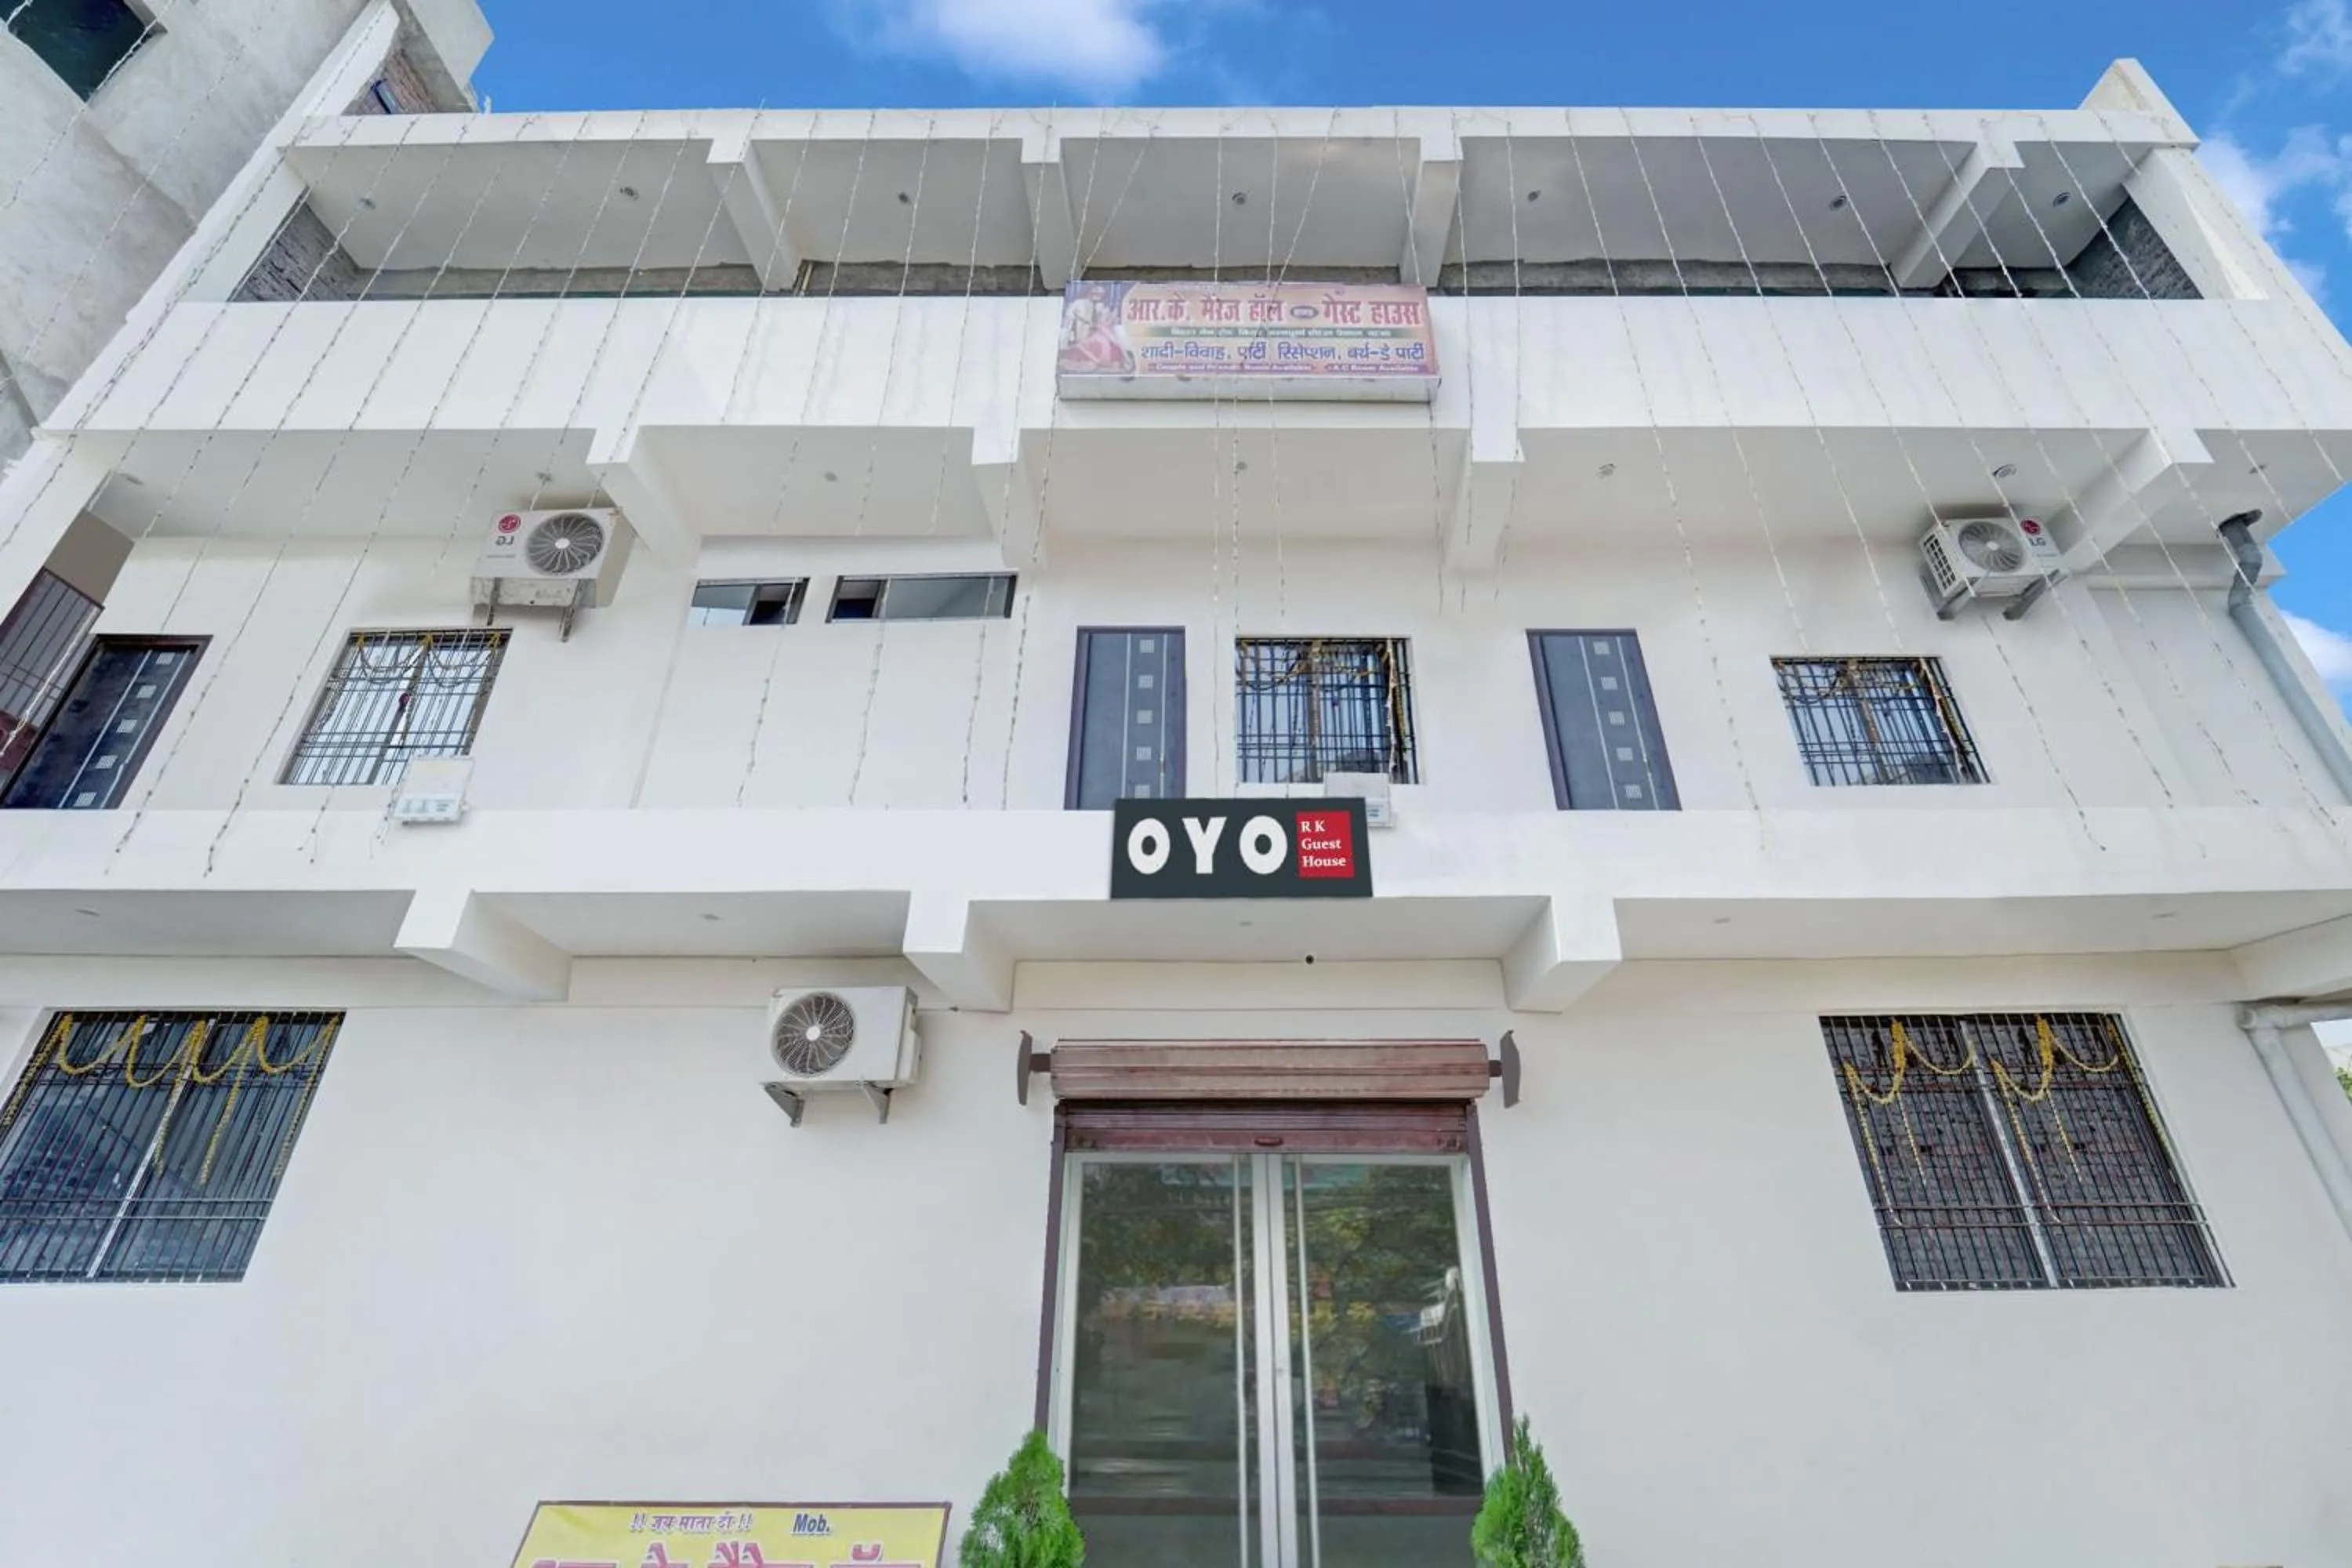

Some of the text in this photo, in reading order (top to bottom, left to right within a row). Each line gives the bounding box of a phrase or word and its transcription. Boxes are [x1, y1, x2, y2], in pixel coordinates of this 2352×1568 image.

[1368, 301, 1421, 325] हाउस
[1301, 821, 1325, 832] R K
[1127, 815, 1287, 875] OYO
[1301, 838, 1341, 851] Guest
[1302, 855, 1346, 867] House
[793, 1513, 831, 1534] Mob.
